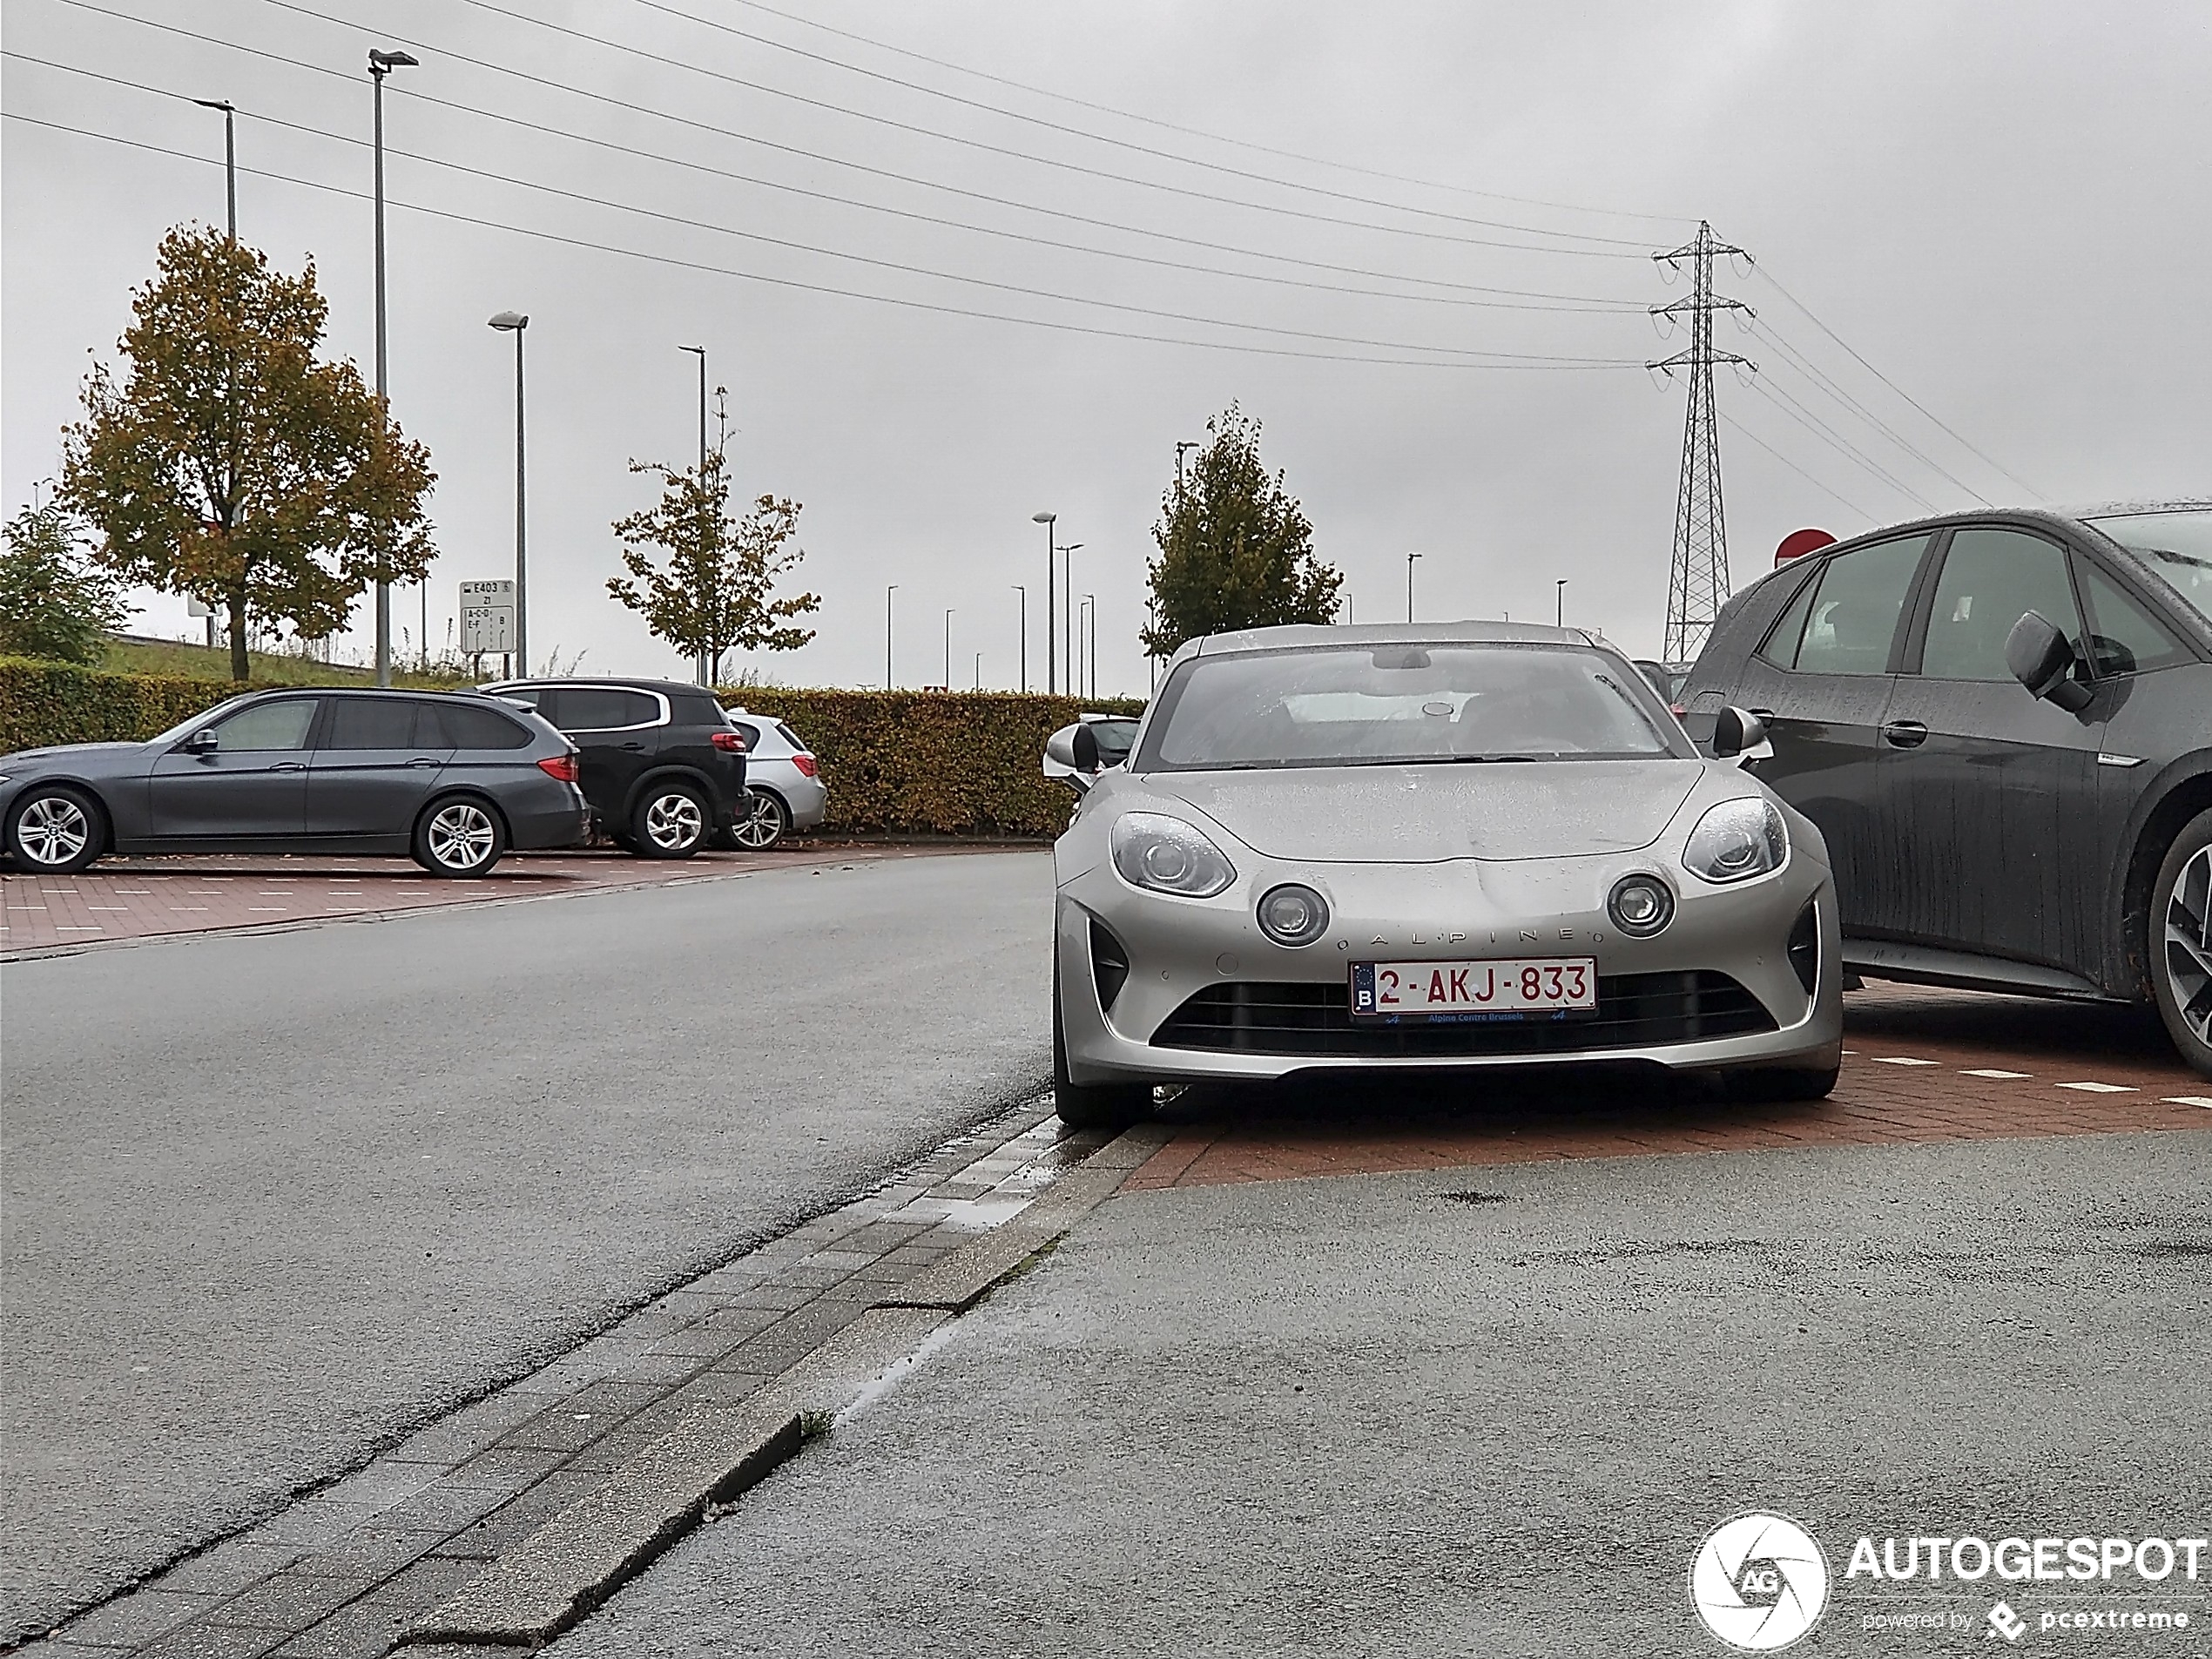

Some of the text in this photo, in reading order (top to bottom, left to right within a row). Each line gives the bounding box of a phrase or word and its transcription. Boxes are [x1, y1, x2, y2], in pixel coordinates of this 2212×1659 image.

[474, 583, 497, 593] E403
[468, 620, 481, 629] E-F
[499, 616, 505, 624] B
[1370, 927, 1574, 945] ALPINE
[1359, 966, 1586, 1006] B 2-AKJ-833
[1428, 1012, 1524, 1023] Alpine Centre Brussels
